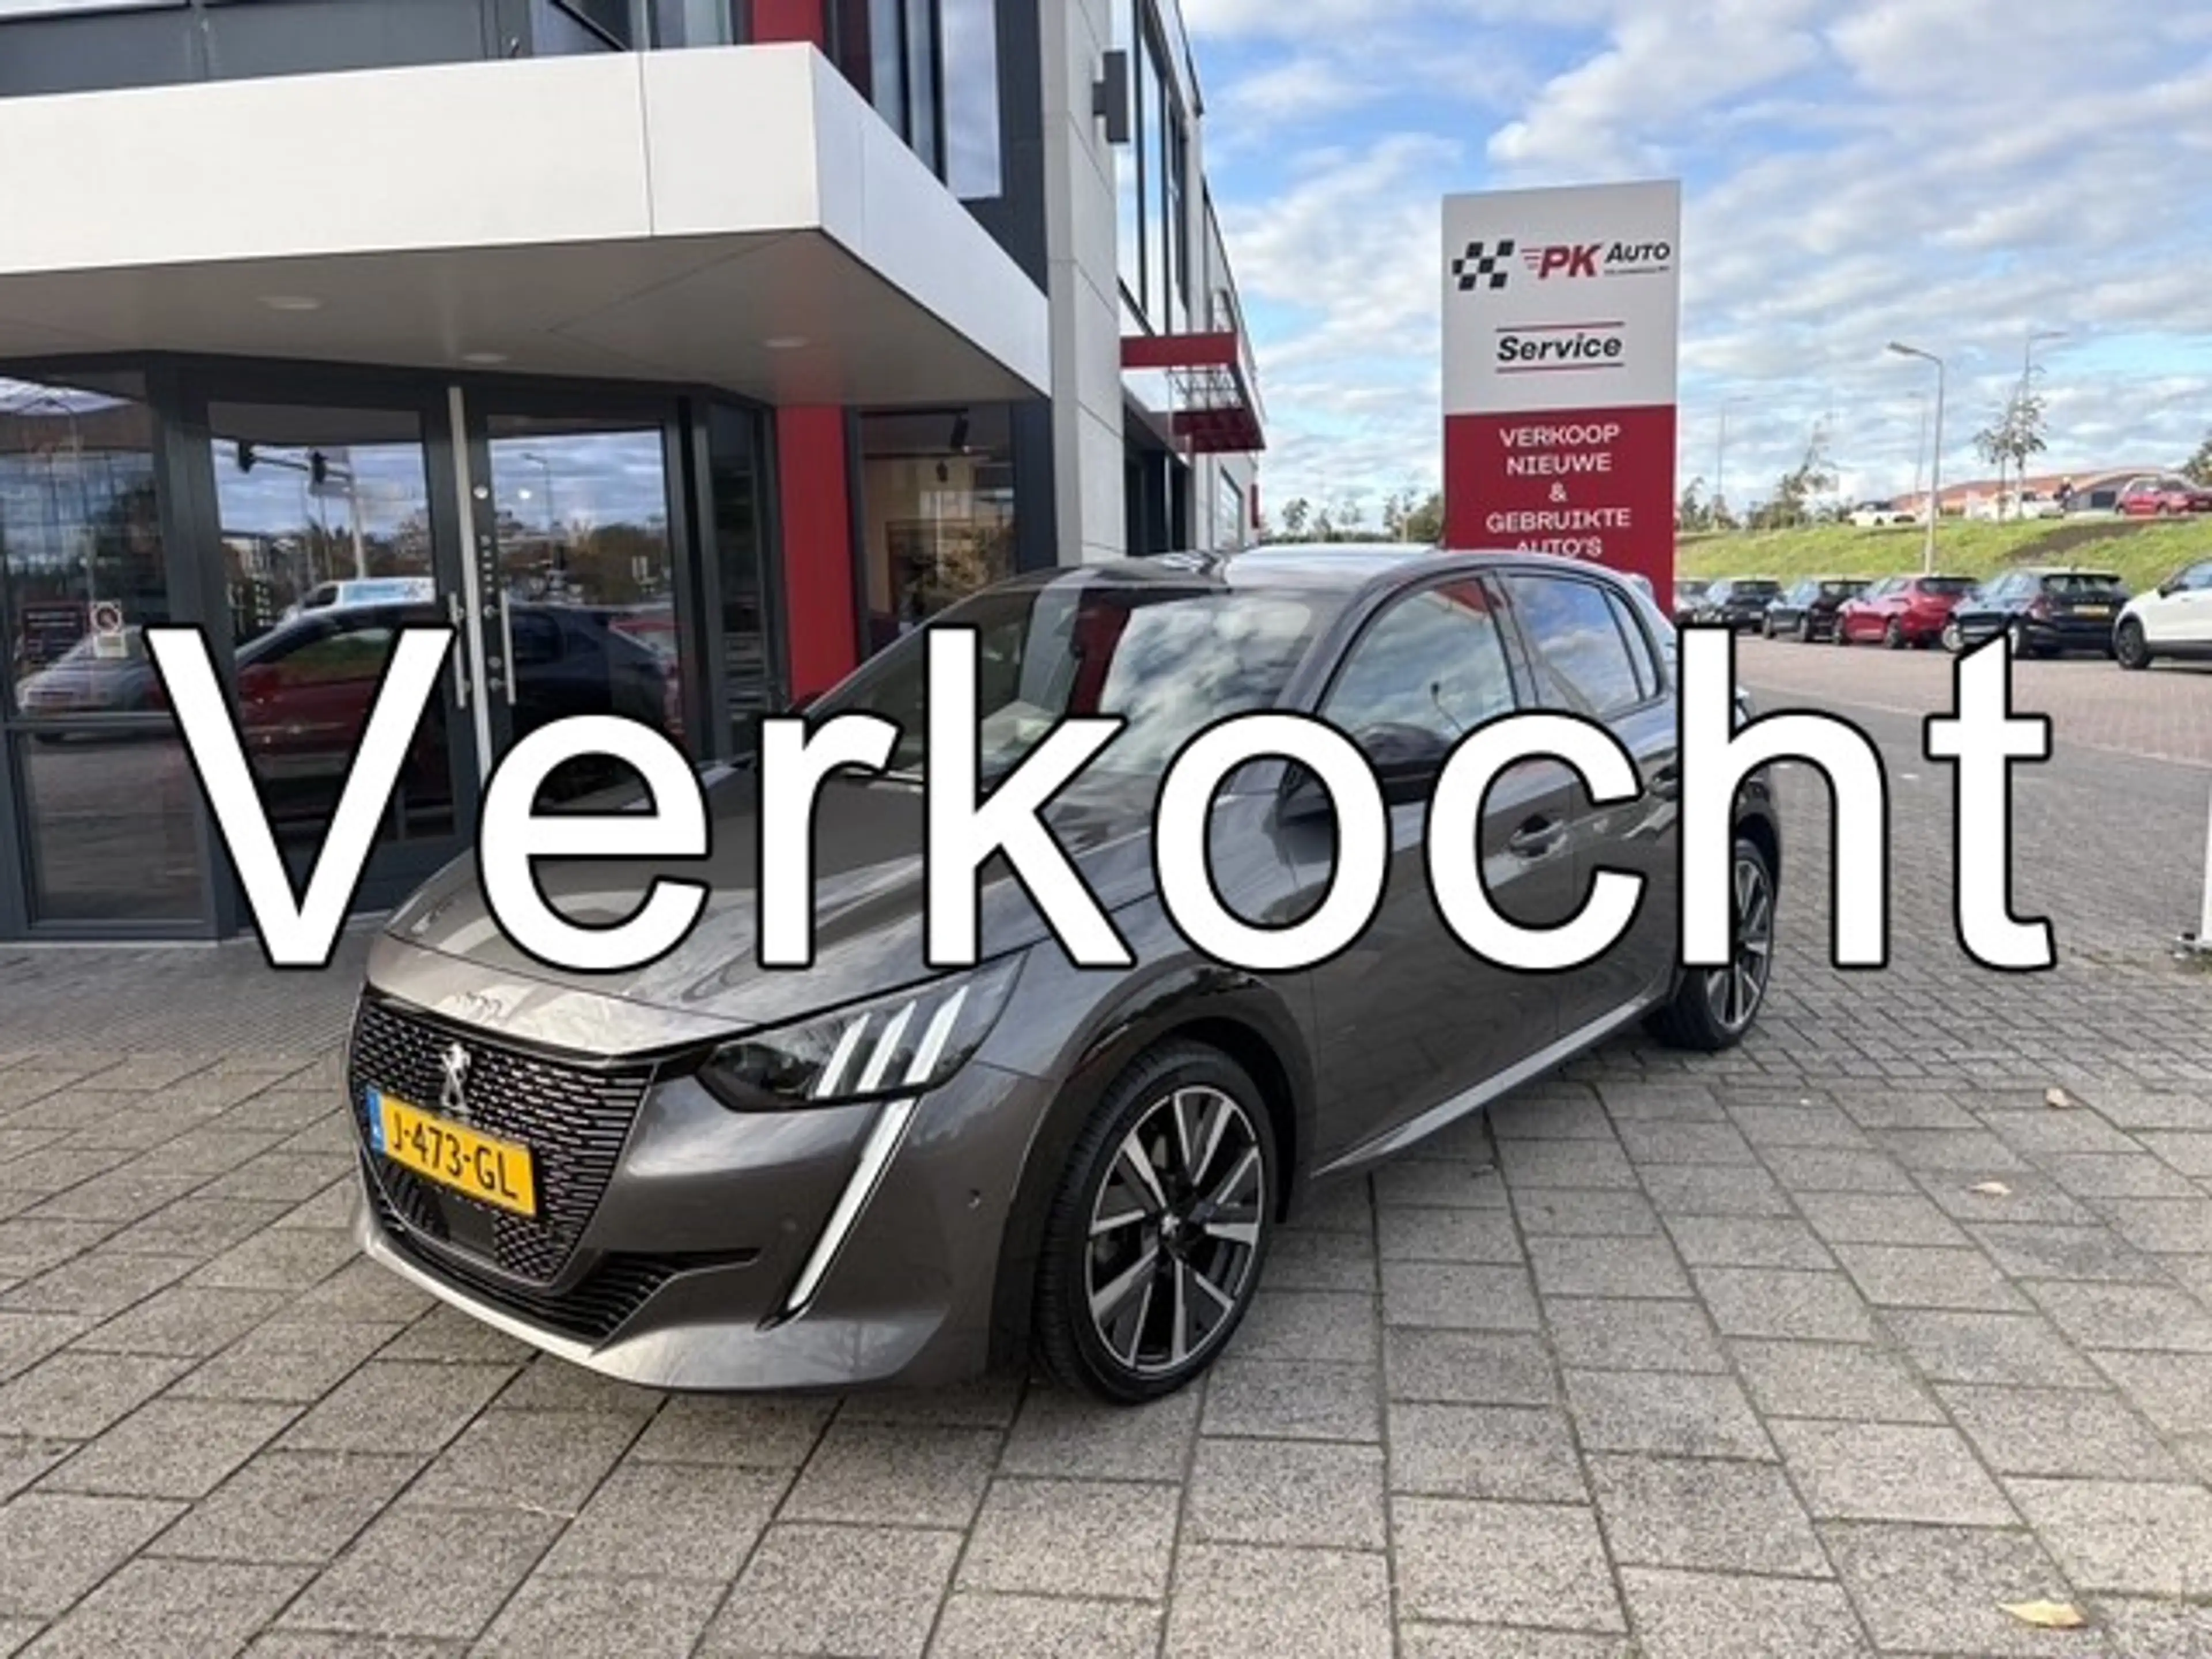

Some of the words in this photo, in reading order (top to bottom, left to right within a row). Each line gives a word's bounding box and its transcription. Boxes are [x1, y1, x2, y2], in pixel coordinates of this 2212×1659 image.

[1537, 243, 1604, 280] PK
[1497, 332, 1623, 362] Service
[1499, 424, 1620, 448] VERKOOP
[1506, 453, 1612, 476] NIEUWE
[1548, 482, 1568, 502] &
[1486, 507, 1631, 533] GEBRUIKTE
[392, 1112, 520, 1200] J-473-GL
